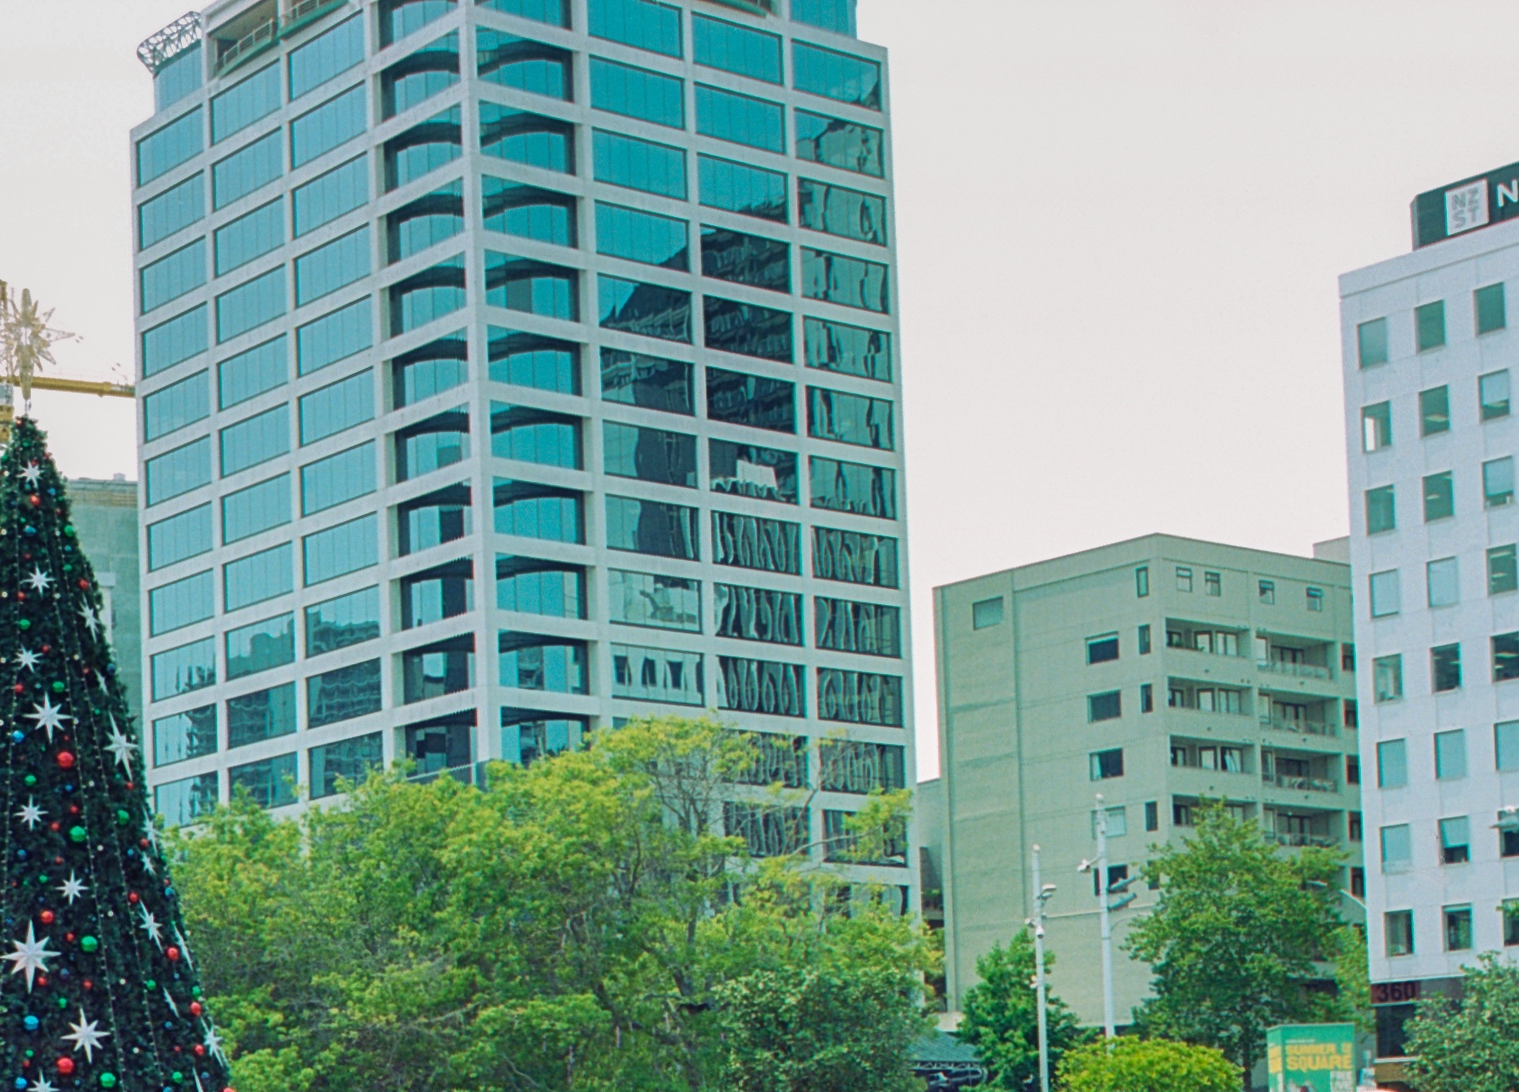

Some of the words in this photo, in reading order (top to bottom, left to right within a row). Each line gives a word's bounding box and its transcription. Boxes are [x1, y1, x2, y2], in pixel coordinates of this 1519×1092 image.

[1451, 185, 1479, 210] NZ
[1452, 205, 1478, 229] ST
[1376, 983, 1416, 1002] 360
[1286, 1054, 1353, 1071] SQUARE
